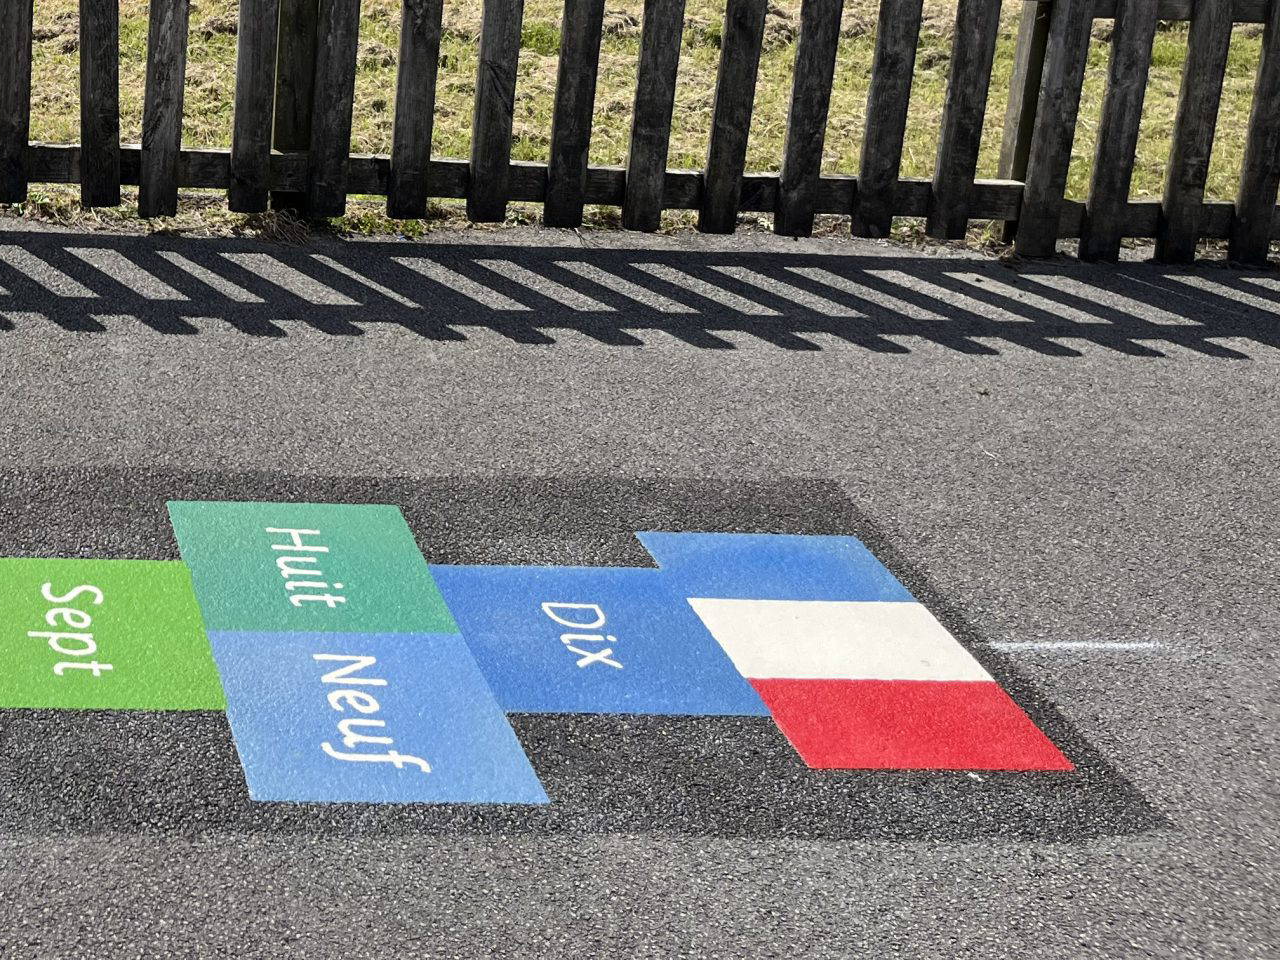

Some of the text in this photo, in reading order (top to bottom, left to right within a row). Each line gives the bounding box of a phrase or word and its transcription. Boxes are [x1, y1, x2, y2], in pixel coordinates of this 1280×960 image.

[265, 527, 346, 608] Huit
[28, 582, 113, 676] Sept
[542, 602, 623, 669] Dix
[313, 653, 431, 773] Neuf
